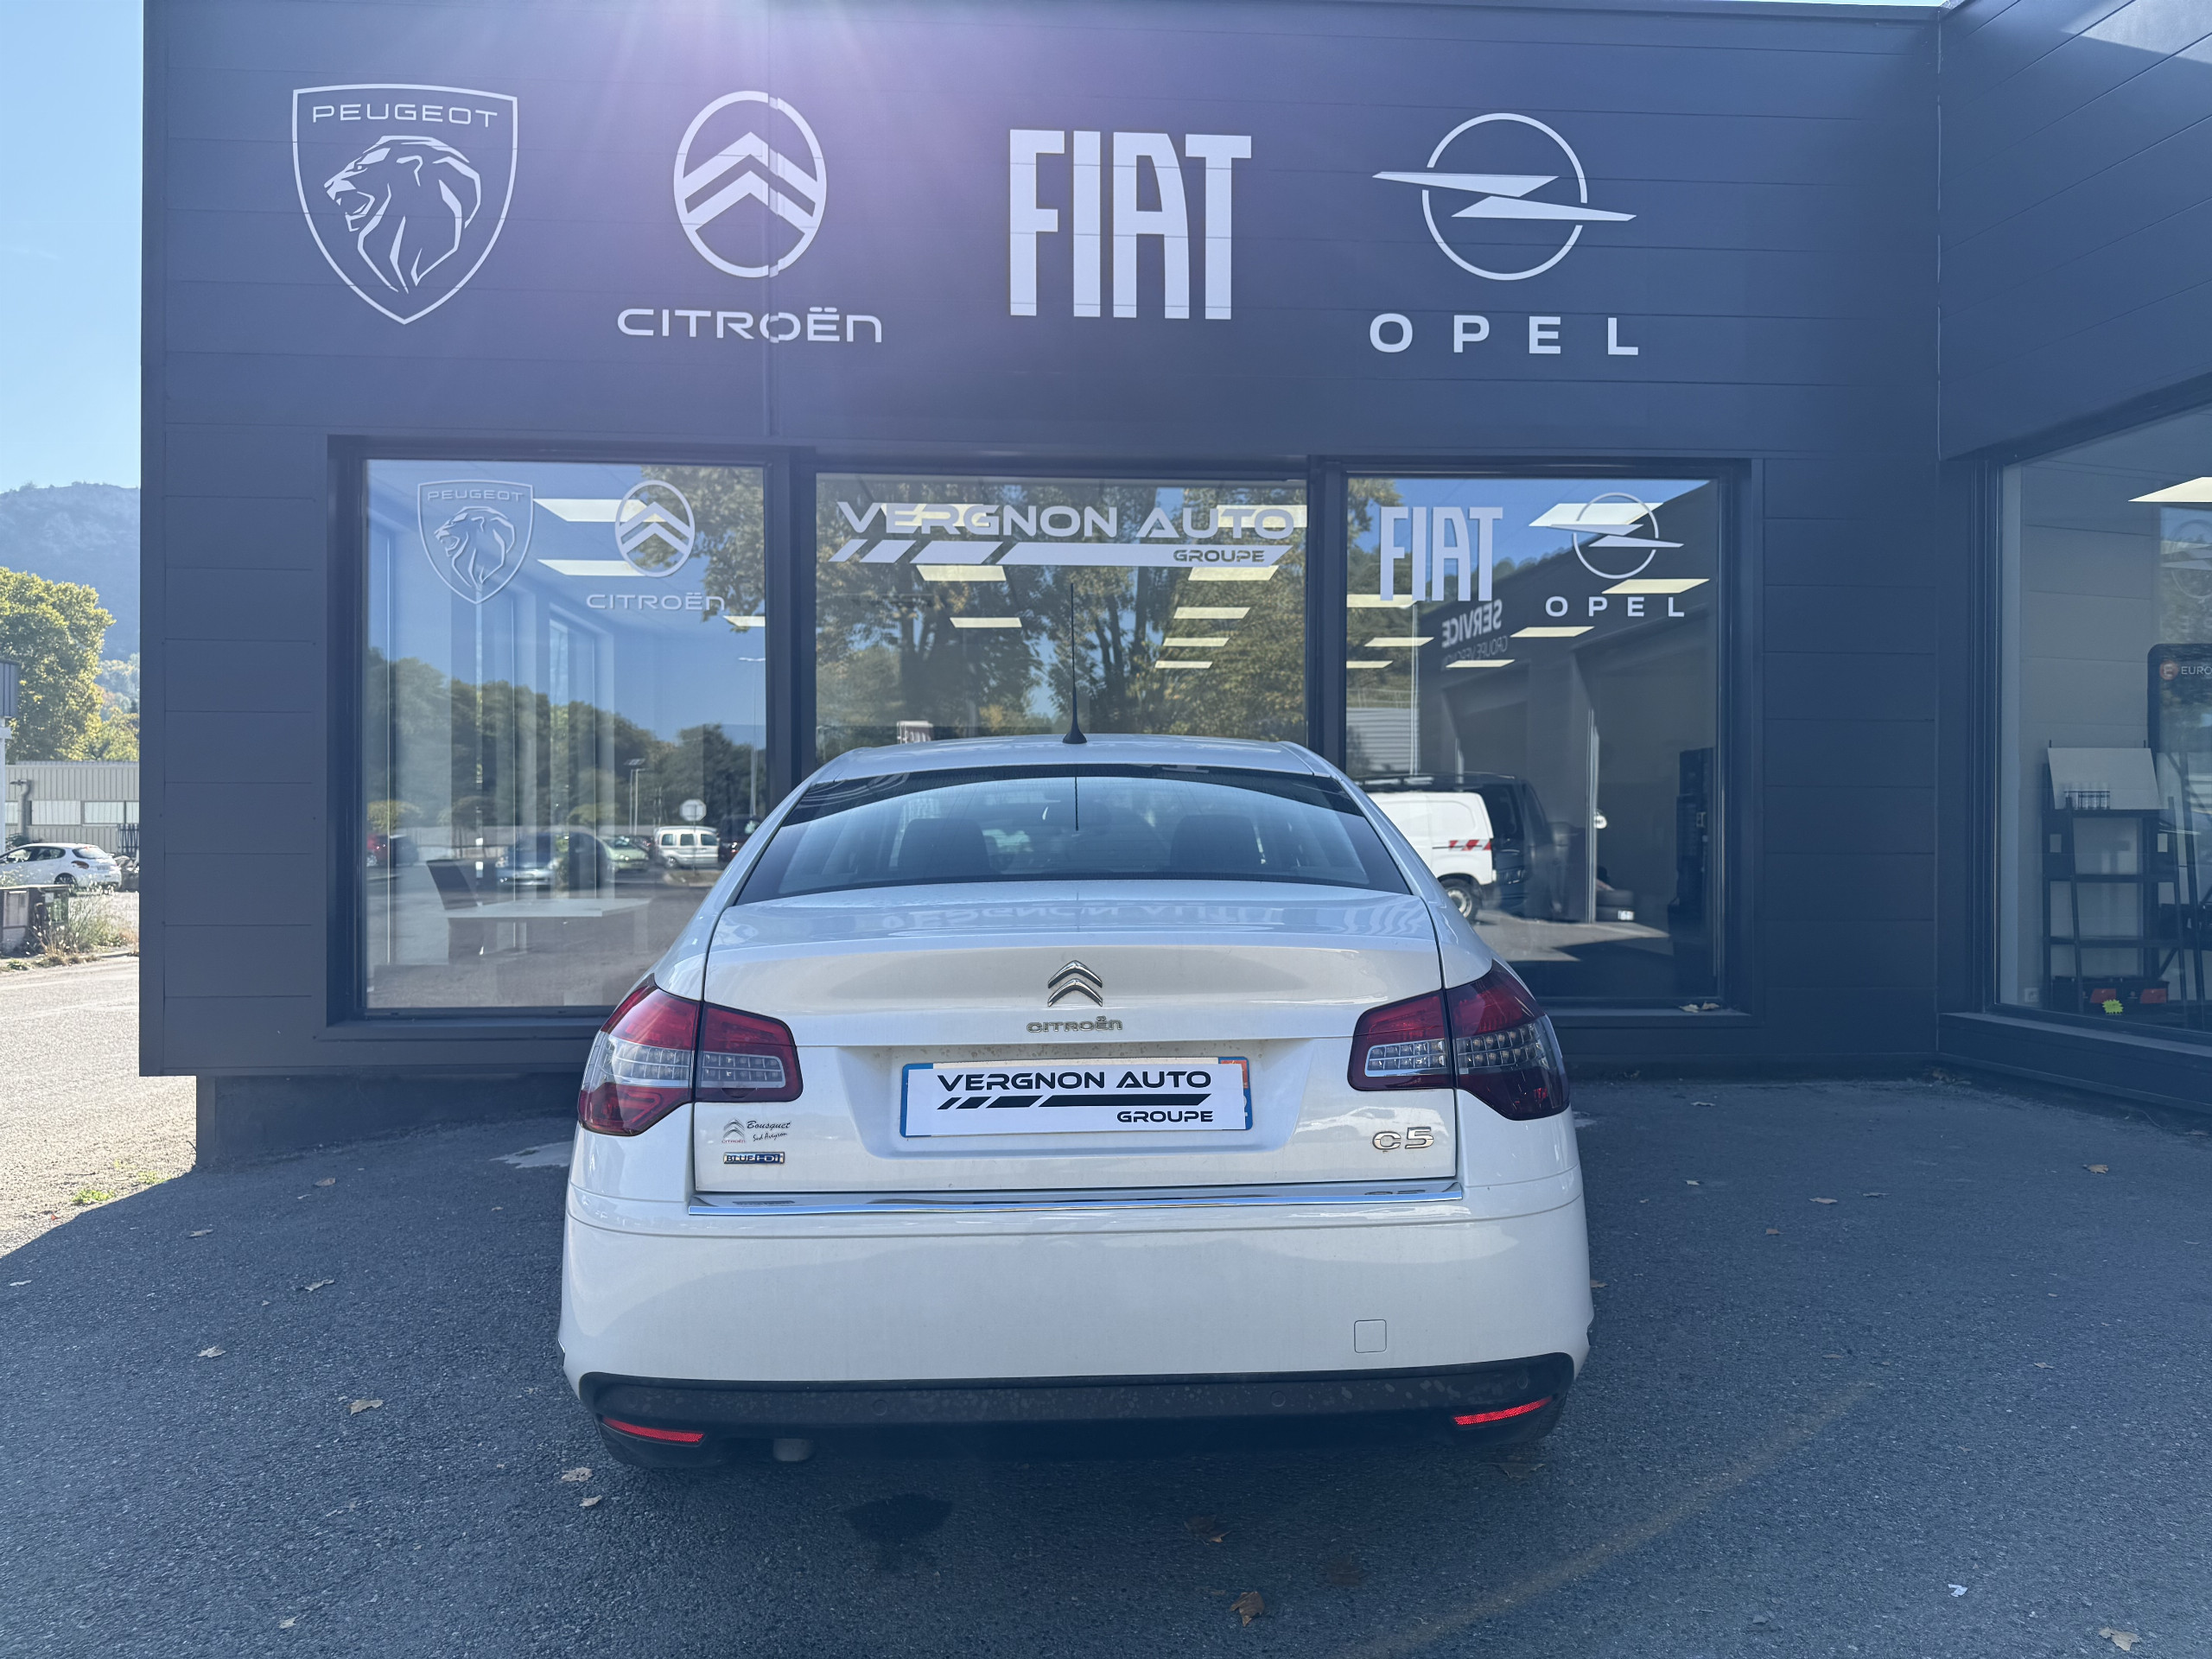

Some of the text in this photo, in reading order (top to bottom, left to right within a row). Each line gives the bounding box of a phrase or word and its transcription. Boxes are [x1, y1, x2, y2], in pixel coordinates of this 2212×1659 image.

[313, 103, 499, 128] PEUGEOT
[1009, 128, 1252, 321] FIAT
[1370, 313, 1638, 356] OPEL
[427, 489, 525, 502] PEUGEOT
[836, 501, 1295, 540] VERGNON AUTO
[1173, 549, 1265, 563] GROUPE
[1380, 506, 1503, 602] FIAT
[1545, 596, 1685, 618] OPEL
[937, 1071, 1211, 1091] VERGNON AUTO
[747, 1120, 792, 1131] Bousquet
[1116, 1110, 1214, 1123] GROUPE
[1372, 1127, 1434, 1150] C5
